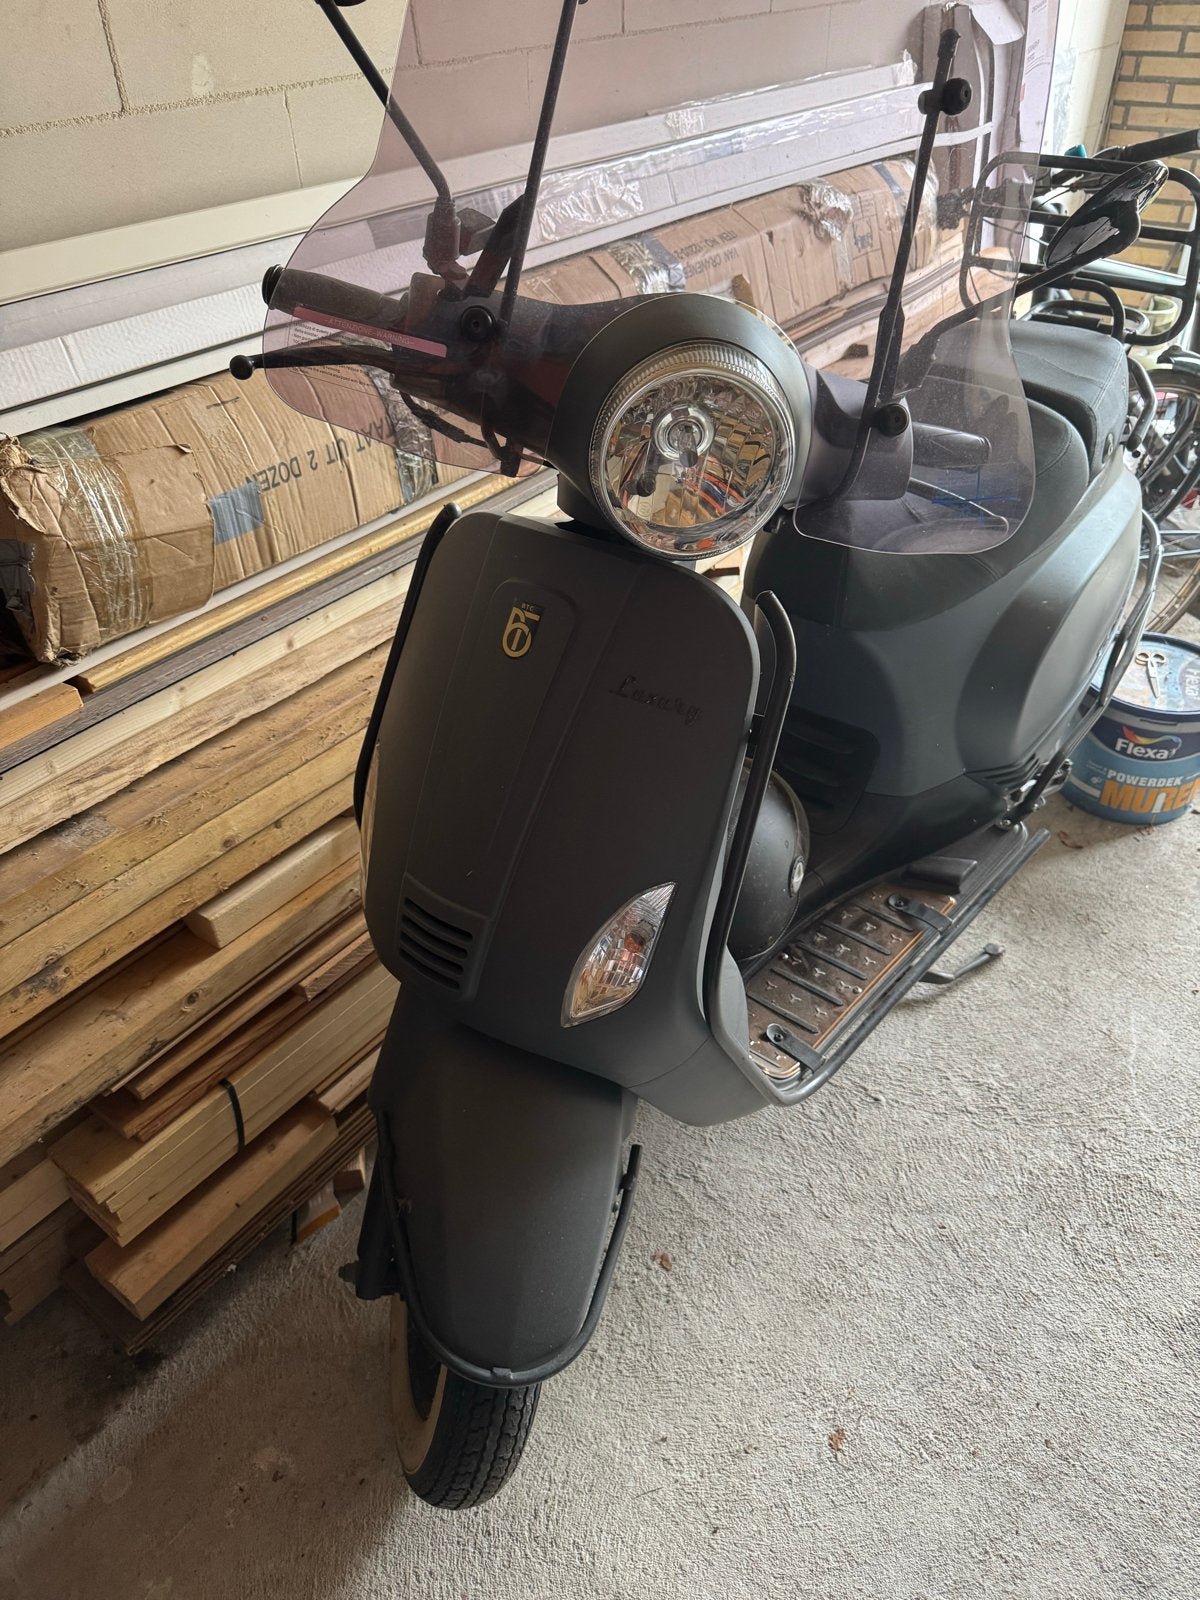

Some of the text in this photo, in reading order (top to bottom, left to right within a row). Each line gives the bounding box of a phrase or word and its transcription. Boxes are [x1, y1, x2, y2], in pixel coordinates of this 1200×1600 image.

[307, 449, 318, 470] 2
[608, 674, 703, 726] Luxury
[1114, 738, 1169, 760] Flexa
[1107, 769, 1184, 788] POWERDEK
